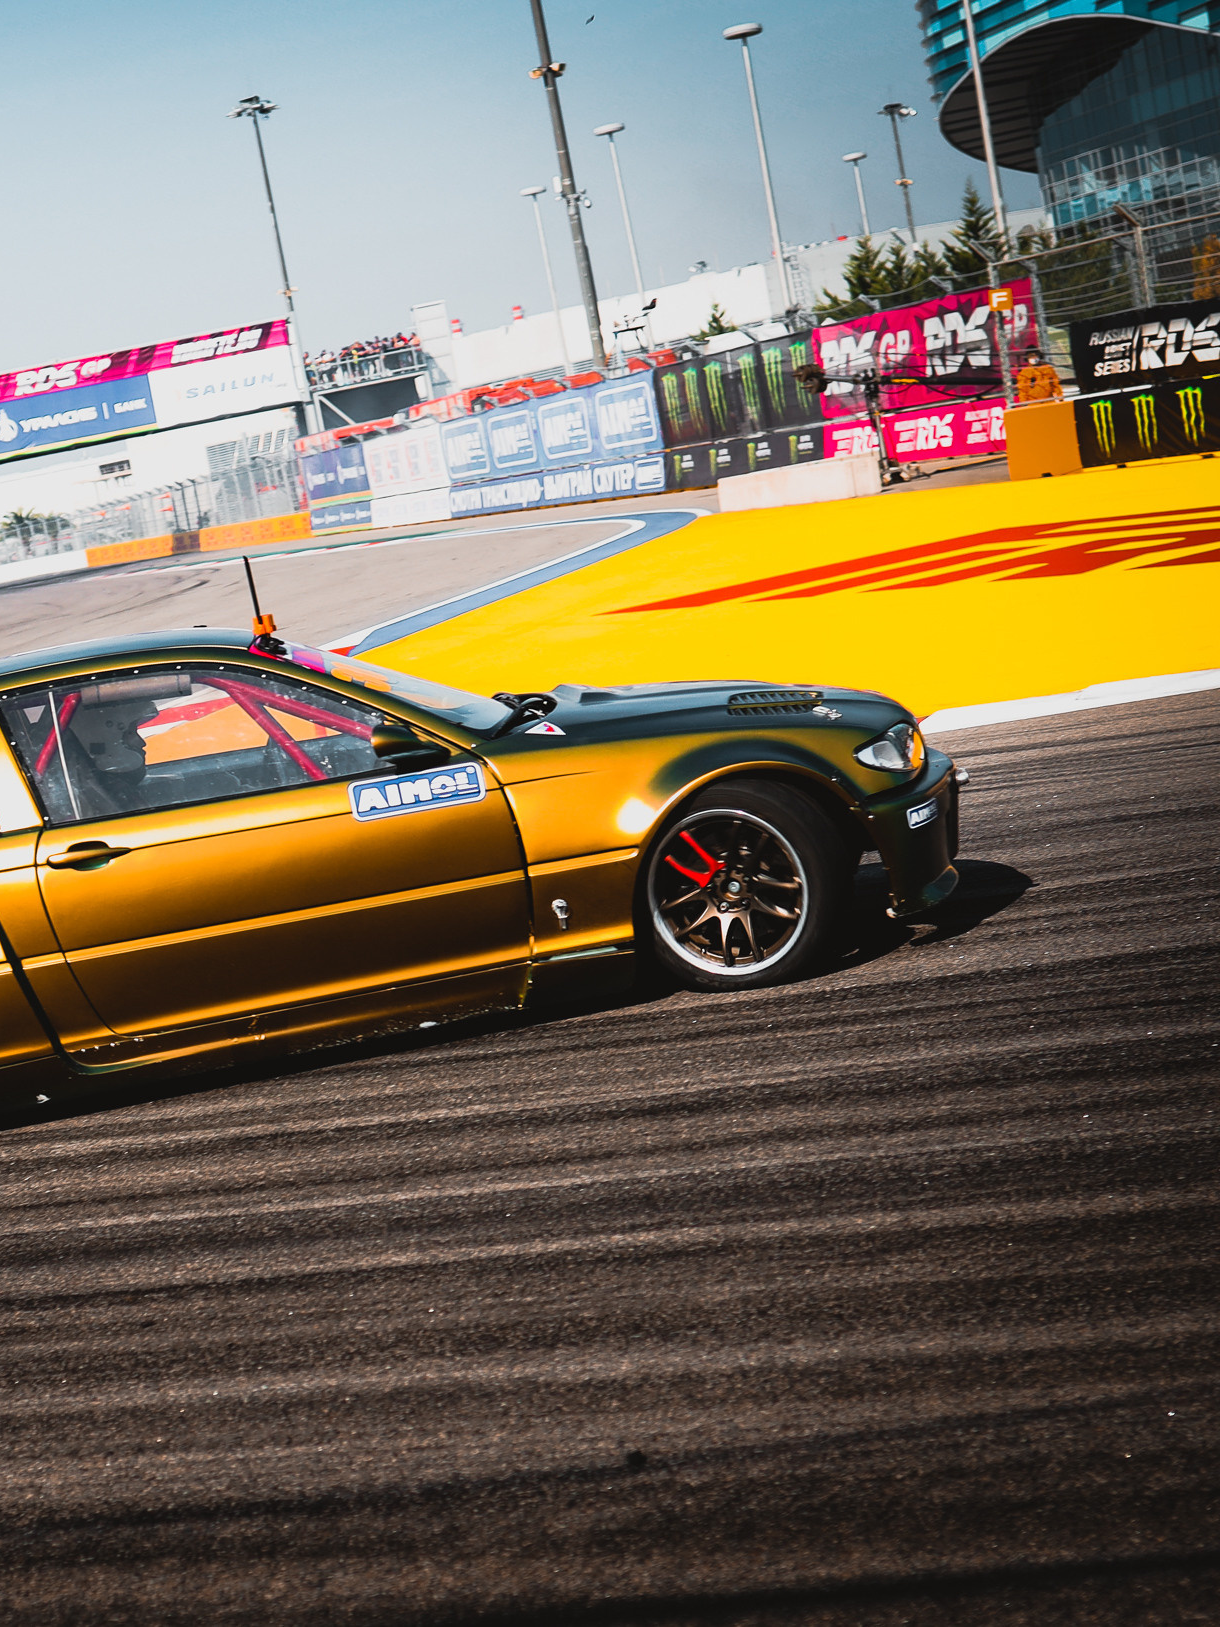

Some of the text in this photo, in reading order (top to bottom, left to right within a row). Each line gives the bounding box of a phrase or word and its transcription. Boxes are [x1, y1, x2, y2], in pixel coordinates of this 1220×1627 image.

[992, 292, 1008, 308] F
[1140, 312, 1220, 370] RDS
[14, 357, 112, 396] RDS GP
[186, 372, 274, 399] SAILUN
[357, 769, 480, 813] AIMOL
